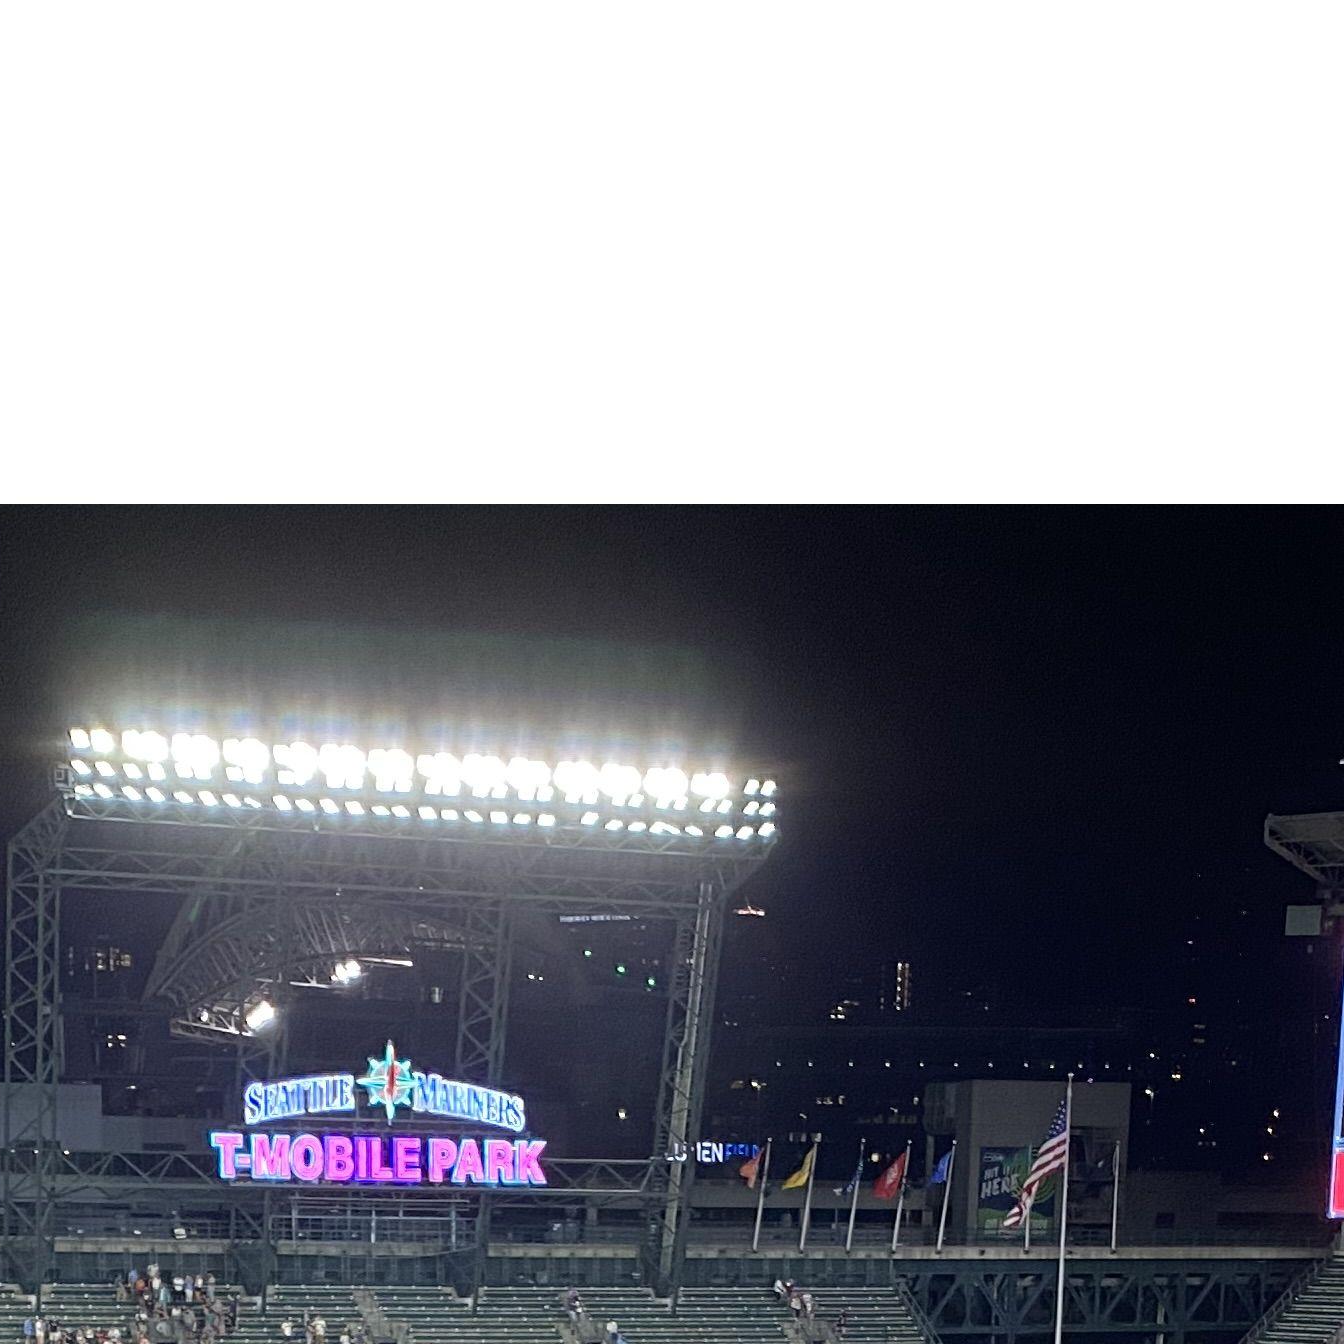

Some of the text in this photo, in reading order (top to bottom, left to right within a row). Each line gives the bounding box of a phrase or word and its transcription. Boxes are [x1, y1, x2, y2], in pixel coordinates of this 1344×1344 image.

[244, 1071, 526, 1132] SEATTLE MARINERS
[210, 1132, 548, 1185] T-MOBILE PARK
[664, 1141, 723, 1162] LUEN
